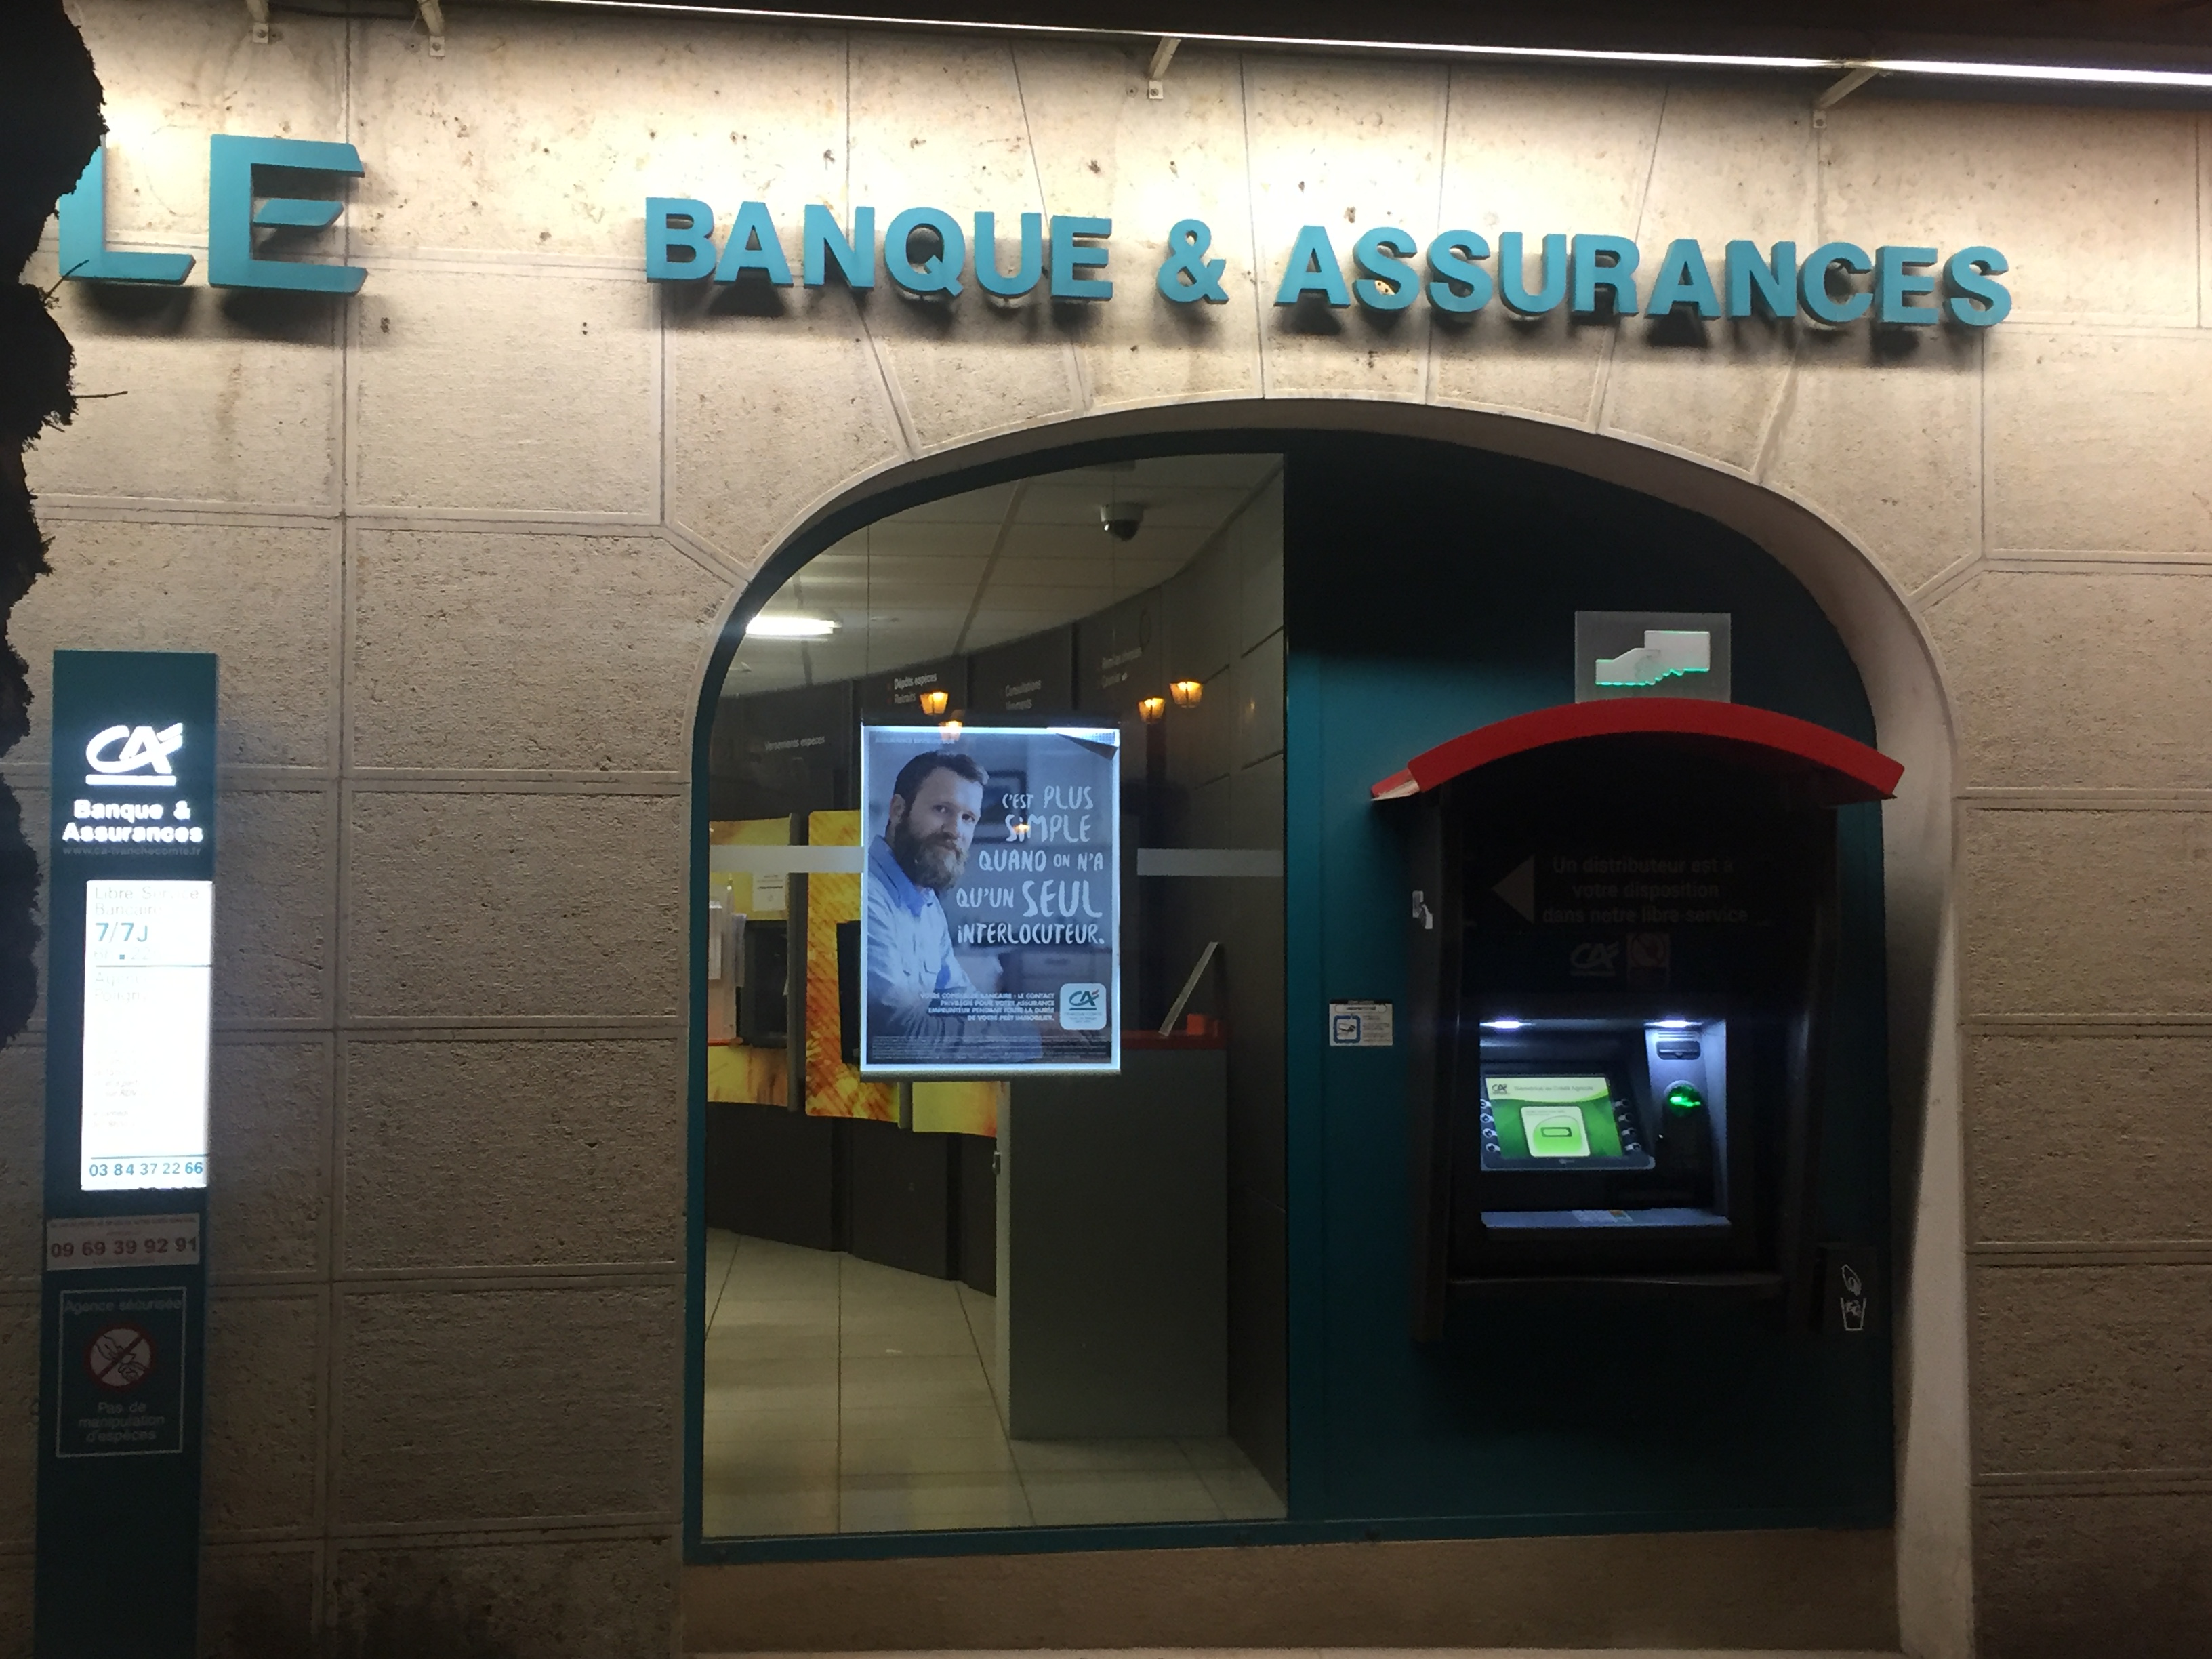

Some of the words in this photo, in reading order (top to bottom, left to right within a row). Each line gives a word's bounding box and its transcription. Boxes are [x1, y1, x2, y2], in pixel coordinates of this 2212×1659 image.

[645, 197, 1113, 302] BANQUE
[1155, 218, 1229, 305] &
[1273, 224, 2012, 329] ASSURANCES
[1002, 793, 1034, 809] C'EST
[1044, 785, 1094, 810] PLUS
[73, 799, 164, 823] Banque
[173, 800, 191, 821] &
[62, 822, 203, 843] Assurances
[978, 849, 1046, 872] QUAND
[1053, 853, 1071, 868] ON
[1077, 852, 1104, 872] N'A
[1553, 856, 1577, 874] Un
[1582, 855, 1685, 874] distributeur
[1691, 858, 1718, 874] est
[1724, 857, 1734, 874] à
[956, 887, 1014, 908] QU'UN
[1021, 879, 1103, 918] SEUL
[1572, 884, 1618, 899] votre
[1624, 881, 1720, 901] disposition
[1542, 907, 1585, 924] dans
[1590, 909, 1637, 924] notre
[89, 1164, 108, 1176] 03
[113, 1163, 135, 1176] 84
[140, 1163, 158, 1175] 37
[163, 1162, 180, 1175] 22
[184, 1162, 203, 1174] 66
[51, 1242, 74, 1258] 09
[81, 1241, 106, 1256] 69
[113, 1240, 137, 1255] 39
[144, 1238, 169, 1254] 92
[174, 1236, 197, 1252] 91
[64, 1300, 115, 1315] Agence
[97, 1401, 123, 1414] Pas
[129, 1400, 147, 1413] de
